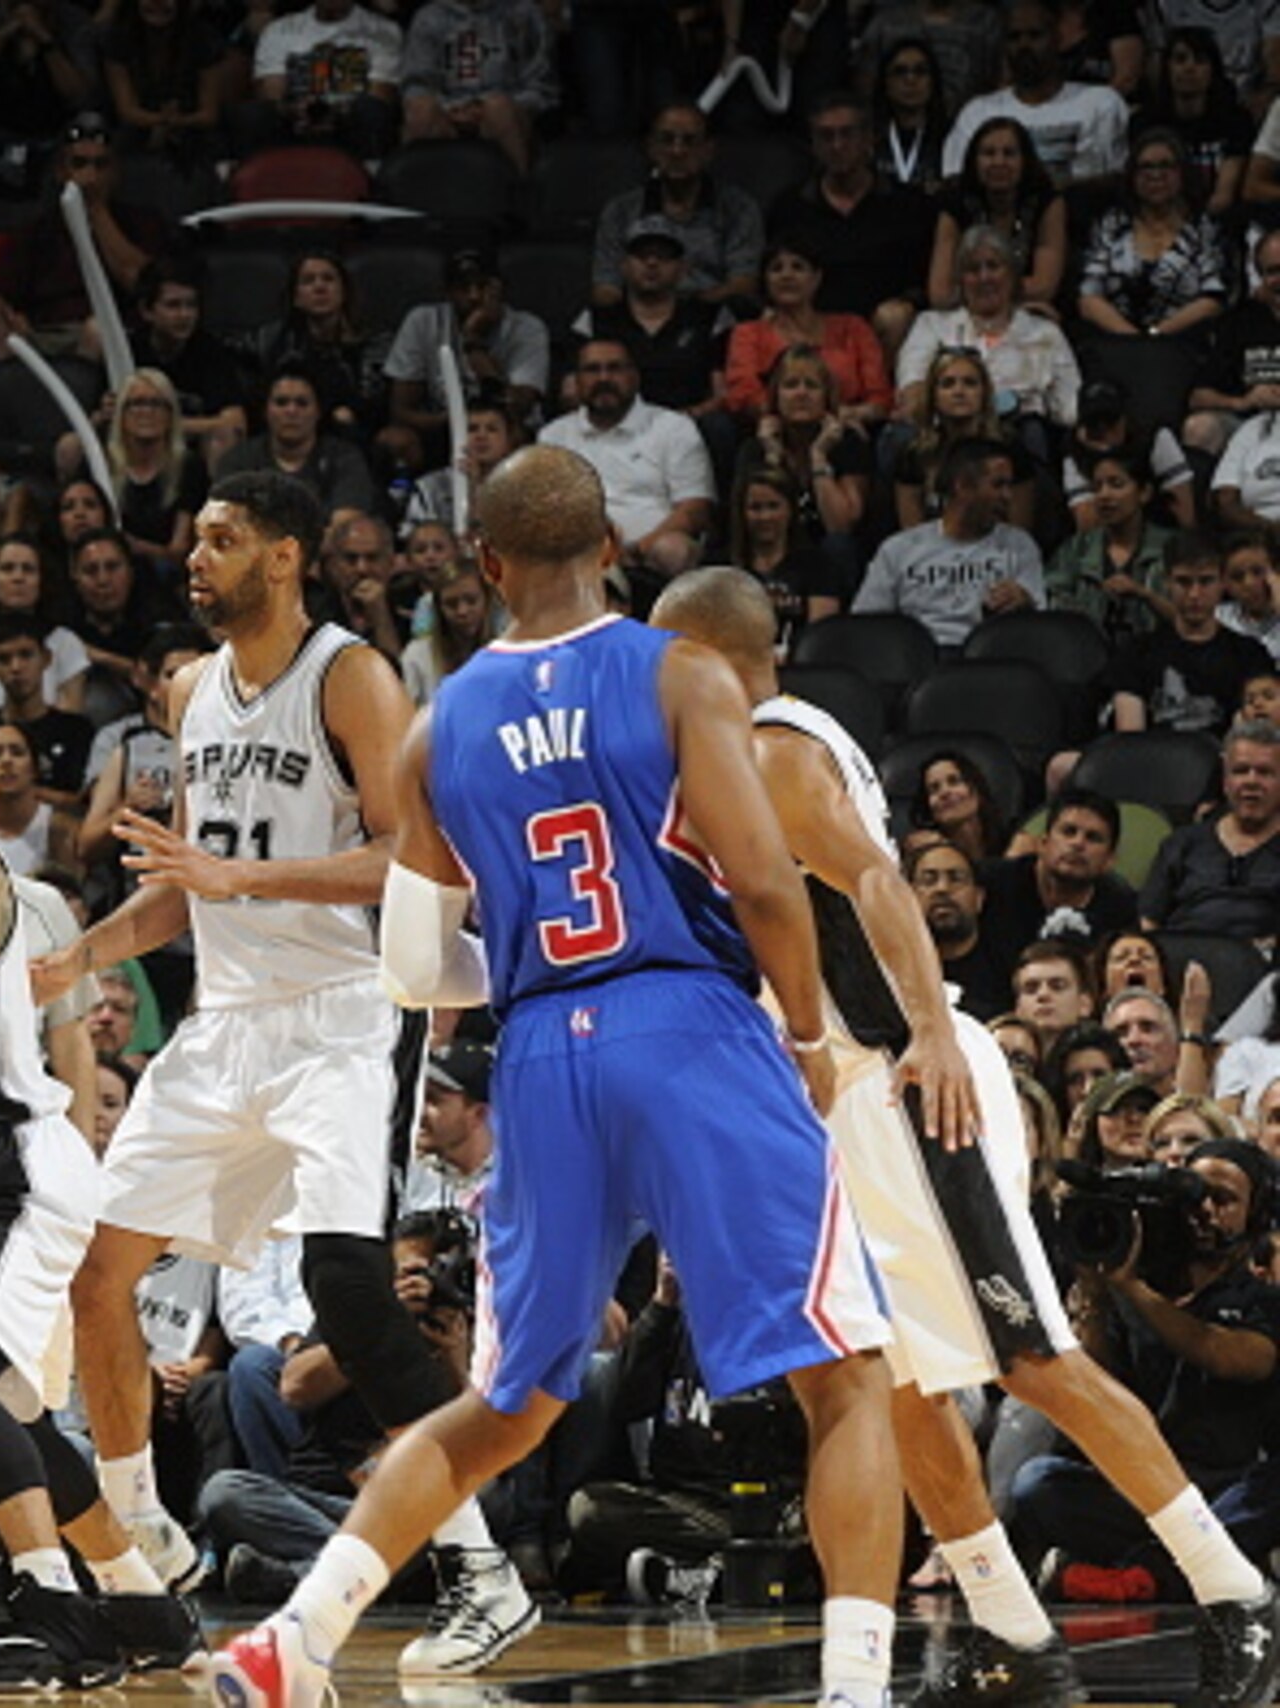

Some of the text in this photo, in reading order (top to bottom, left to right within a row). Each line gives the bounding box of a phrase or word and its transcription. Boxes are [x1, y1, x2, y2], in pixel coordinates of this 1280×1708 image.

[184, 742, 312, 790] SPURS
[497, 708, 587, 774] PAUL
[526, 801, 628, 966] 3
